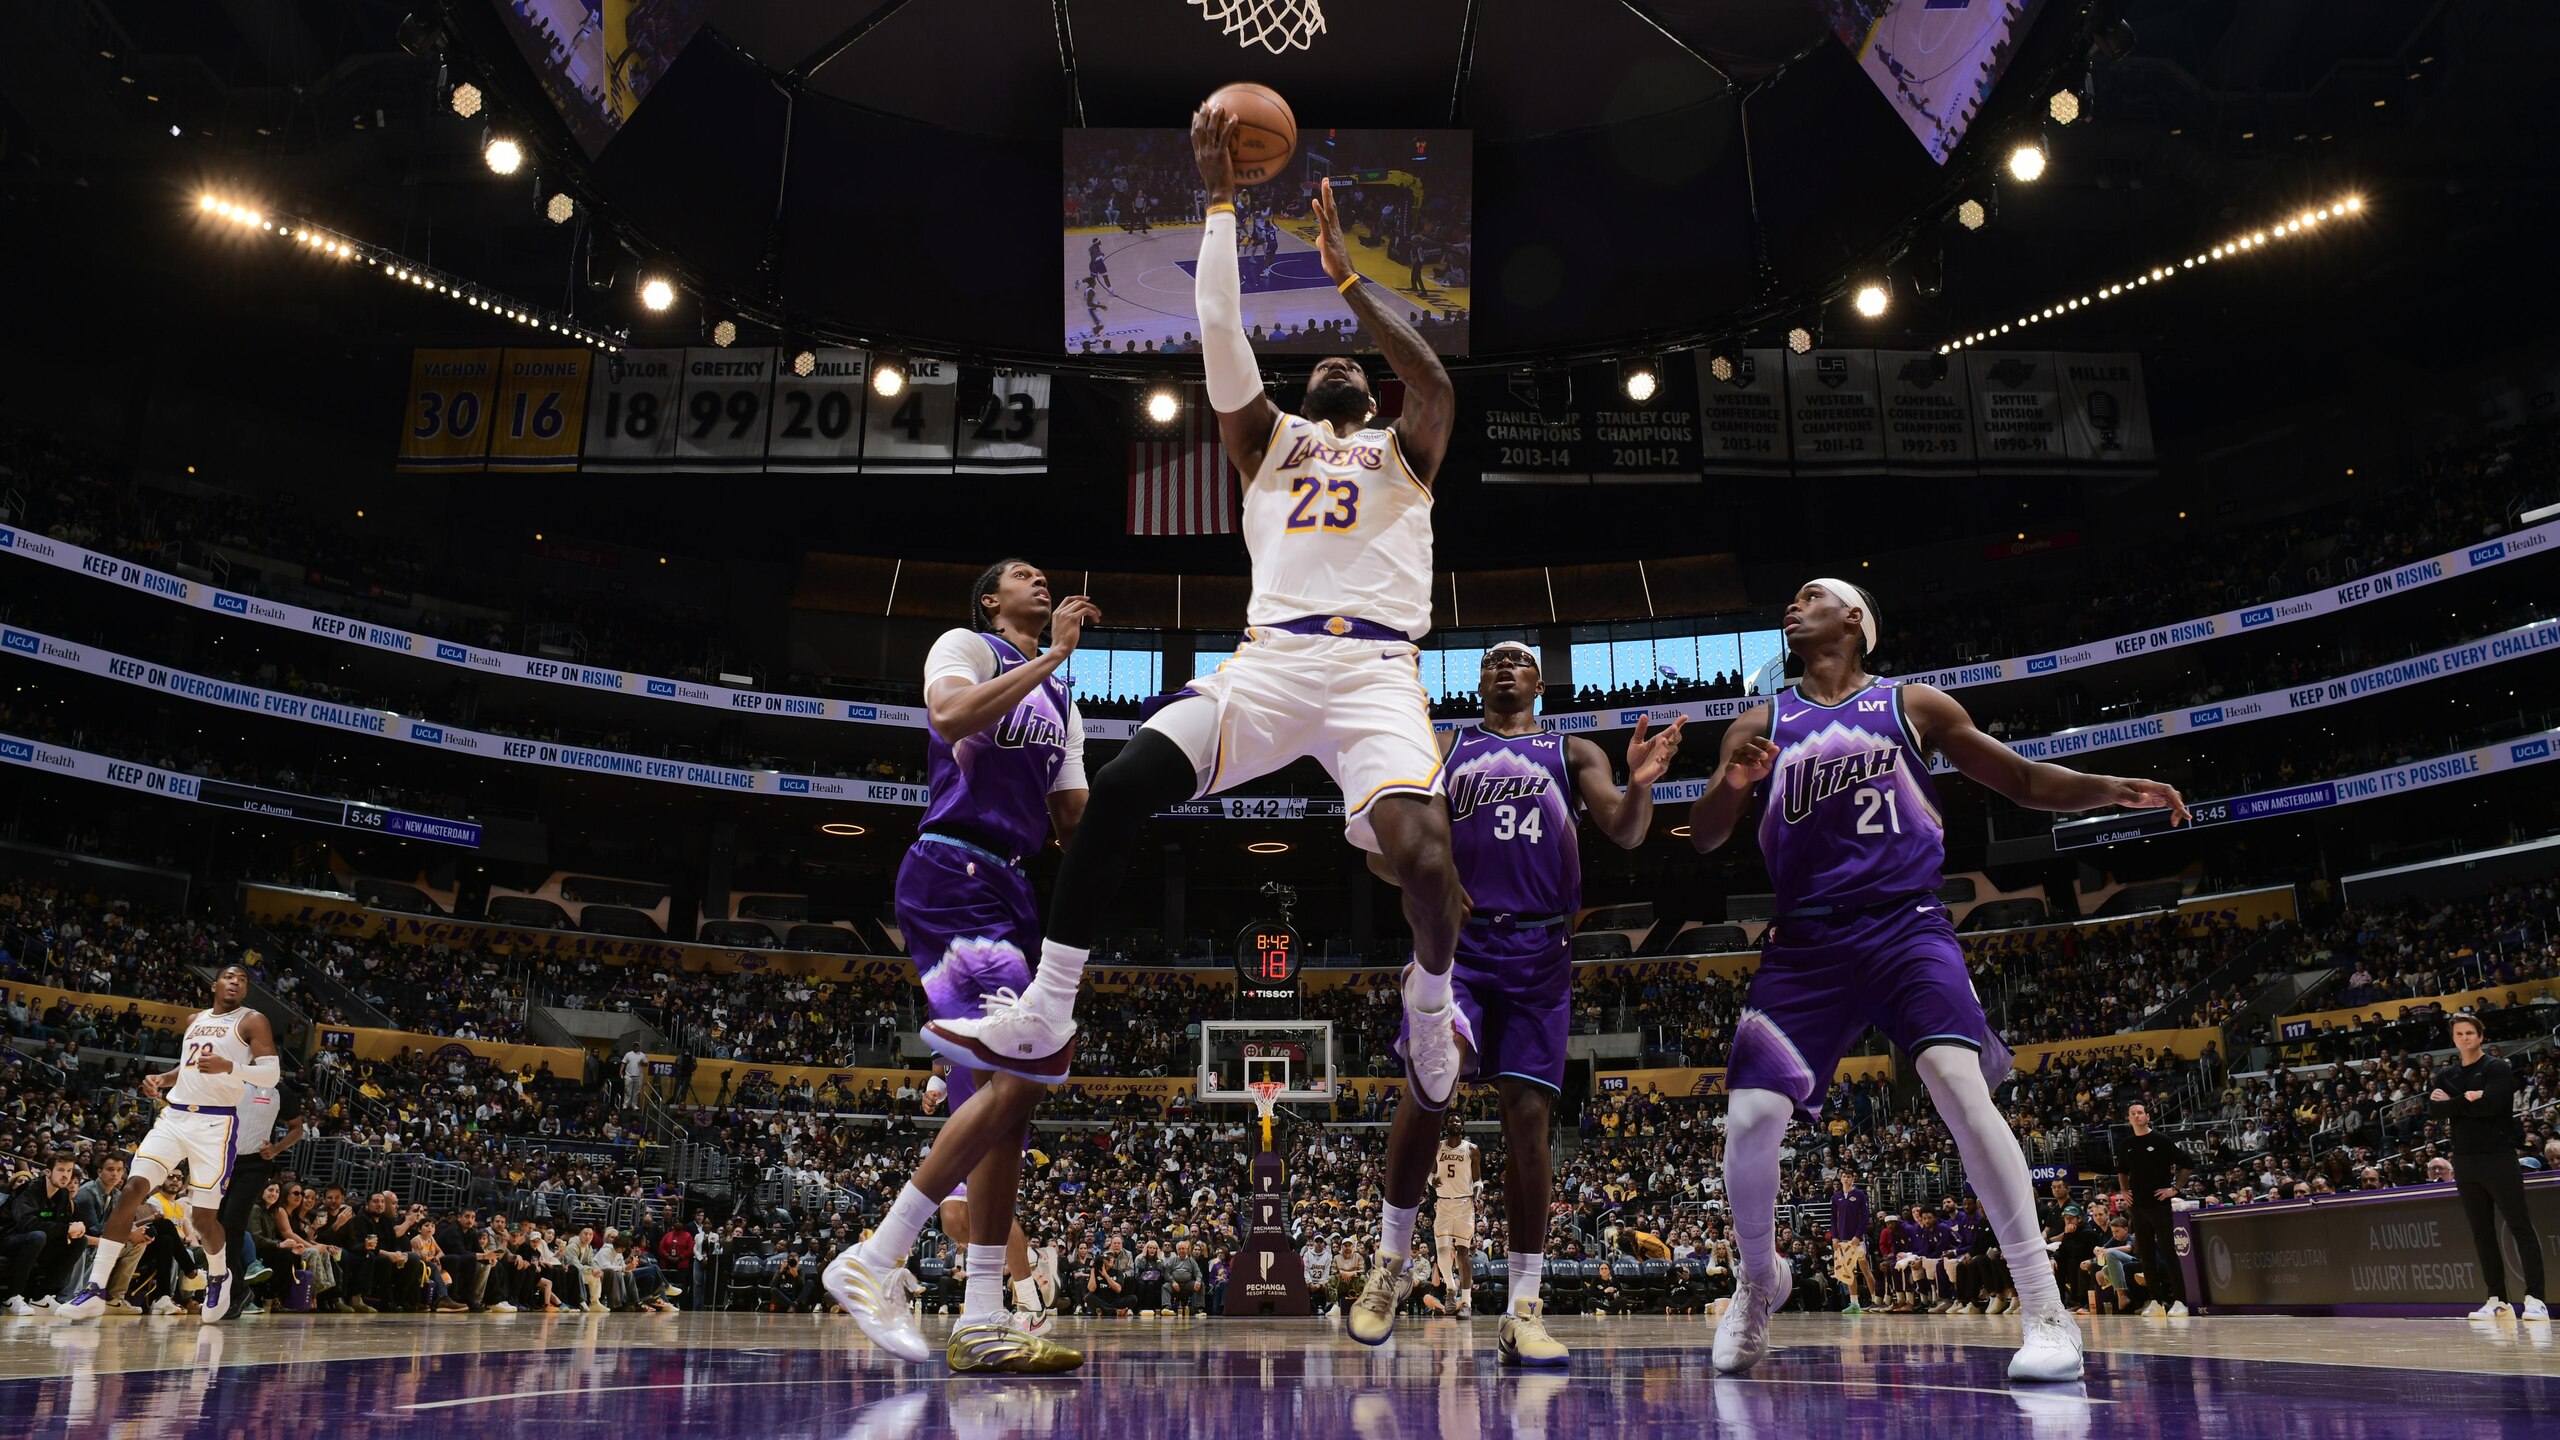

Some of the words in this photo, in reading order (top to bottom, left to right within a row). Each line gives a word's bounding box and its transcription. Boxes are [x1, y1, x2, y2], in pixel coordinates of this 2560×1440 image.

[424, 363, 488, 376] VACHON
[513, 363, 577, 376] DIONNE
[691, 360, 765, 376] GRETZKY
[1817, 358, 1846, 370] LA
[2070, 366, 2130, 382] MILLER
[1712, 394, 1770, 406] WESTERN
[1806, 394, 1864, 406] WESTERN
[1894, 394, 1955, 406] CAMPBELL
[1992, 394, 2038, 406] SMYTHE
[413, 391, 480, 439] 30
[511, 392, 564, 439] 16
[605, 391, 657, 438] 18
[689, 391, 760, 439] 99
[780, 390, 852, 439] 20
[891, 392, 924, 440] 4
[972, 393, 1035, 440] 23
[1596, 412, 1659, 425] STANLEY
[1662, 412, 1691, 425] CUP
[1706, 408, 1780, 421] CONFERENCE
[1797, 408, 1876, 420] CONFERENCE
[1888, 408, 1965, 420] CONFERENCE
[1990, 408, 2044, 420] DIVISION
[1486, 425, 1582, 442] CHAMPIONS
[1711, 420, 1778, 434] CHAMPIONS
[1802, 420, 1873, 434] CHAMPIONS
[1893, 421, 1962, 434] CHAMPIONS
[1984, 420, 2054, 432] CHAMPIONS
[1596, 427, 1692, 442] CHAMPIONS
[1721, 437, 1770, 452] 2013-14
[1814, 438, 1864, 452] 2011-12
[1902, 438, 1957, 452] 1992-93
[1277, 436, 1383, 471] LAKERS
[1500, 447, 1571, 466] 2013-14
[1612, 449, 1680, 466] 2011-12
[1286, 475, 1360, 534] 23
[16, 537, 55, 558] Health
[2506, 534, 2546, 553] Health
[83, 554, 118, 577] KEEP
[122, 566, 141, 585] ON
[143, 573, 188, 599] RISING
[2338, 582, 2370, 604] KEEP
[2374, 576, 2393, 594] ON
[2396, 561, 2442, 588] RISING
[218, 596, 244, 612] UCLA
[250, 604, 286, 620] Health
[2276, 602, 2312, 618] Health
[312, 615, 345, 635] KEEP
[349, 624, 366, 641] ON
[370, 628, 412, 650] RISING
[2115, 636, 2146, 656] KEEP
[2150, 631, 2168, 648] ON
[2172, 620, 2215, 642] RISING
[7, 636, 34, 650] UCLA
[42, 642, 80, 662] Health
[468, 652, 501, 668] Health
[2058, 651, 2092, 666] Health
[526, 661, 558, 678] KEEP
[562, 666, 578, 682] ON
[582, 670, 623, 689] RISING
[2289, 687, 2324, 708] KEEP
[2329, 681, 2347, 699] ON
[2351, 658, 2440, 695] OVERCOMING
[2443, 644, 2487, 670] EVERY
[2492, 626, 2560, 658] CHALLEN
[1940, 672, 1957, 686] ON
[1960, 665, 2002, 684] RISING
[109, 658, 144, 680] KEEP
[148, 668, 167, 687] ON
[170, 674, 260, 708] OVERCOMING
[264, 695, 308, 717] EVERY
[310, 704, 386, 732] CHALLENGE
[678, 686, 709, 700] Health
[732, 693, 762, 708] KEEP
[765, 697, 782, 711] ON
[785, 699, 825, 715] RISING
[1705, 702, 1736, 717] KEEP
[1858, 700, 1888, 712] LVT
[2225, 703, 2262, 718] Health
[879, 710, 910, 722] Health
[1541, 719, 1556, 730] ON
[1560, 715, 1598, 730] RISING
[444, 734, 478, 748] Health
[1532, 738, 1556, 750] LVT
[2050, 733, 2090, 754] EVERY
[2092, 719, 2164, 746] CHALLENGE
[36, 750, 75, 768] Health
[2516, 744, 2545, 758] UCLA
[504, 741, 536, 758] KEEP
[540, 746, 558, 762] ON
[561, 750, 642, 774] OVERCOMING
[646, 762, 684, 780] EVERY
[687, 766, 755, 789] CHALLENGE
[107, 763, 143, 785] KEEP
[146, 772, 166, 790] ON
[2336, 777, 2378, 800] EVING
[2381, 771, 2407, 791] IT'S
[2410, 754, 2480, 784] POSSIBLE
[811, 782, 844, 794] Health
[868, 785, 898, 800] KEEP
[901, 787, 918, 802] ON
[1782, 746, 1902, 825] UTAH
[1452, 770, 1554, 822] UTAH
[2250, 798, 2270, 813] NEW
[2270, 790, 2324, 810] AMSTERDAM
[244, 800, 258, 811] UC
[260, 802, 293, 817] Alumni
[1170, 803, 1210, 814] Lakers
[1232, 800, 1280, 818] 8:42
[1289, 804, 1306, 818] 1st
[1854, 788, 1902, 835] 21
[2196, 806, 2227, 822] 5:45
[350, 810, 382, 827] 5:45
[1494, 804, 1542, 844] 34
[404, 820, 422, 833] NEW
[422, 822, 470, 842] AMSTERDAM
[2096, 832, 2110, 842] UC
[2111, 828, 2141, 840] Alumni
[294, 906, 368, 928] LOS
[371, 916, 536, 950] ANGELES
[544, 936, 684, 962] LAKERS
[1256, 934, 1290, 950] 8:42
[840, 960, 906, 976] LOS
[1262, 950, 1286, 978] 18
[1256, 990, 1294, 999] TISSOT
[186, 1025, 229, 1040] LAKERS
[2286, 1023, 2306, 1038] 117
[2059, 1048, 2086, 1058] LOS
[653, 1063, 673, 1075] 115
[1117, 1084, 1168, 1092] ANGELES
[1603, 1078, 1624, 1090] 116
[1440, 1152, 1464, 1162] LAKERS
[1447, 1165, 1456, 1178] 5
[2369, 1226, 2381, 1250] A
[2382, 1221, 2442, 1250] UNIQUE
[2234, 1252, 2252, 1269] THE
[2254, 1249, 2328, 1268] COSMOPOLITAN
[1312, 1270, 1322, 1278] 23
[2350, 1264, 2407, 1292] LUXURY
[2410, 1262, 2475, 1290] RESORT
